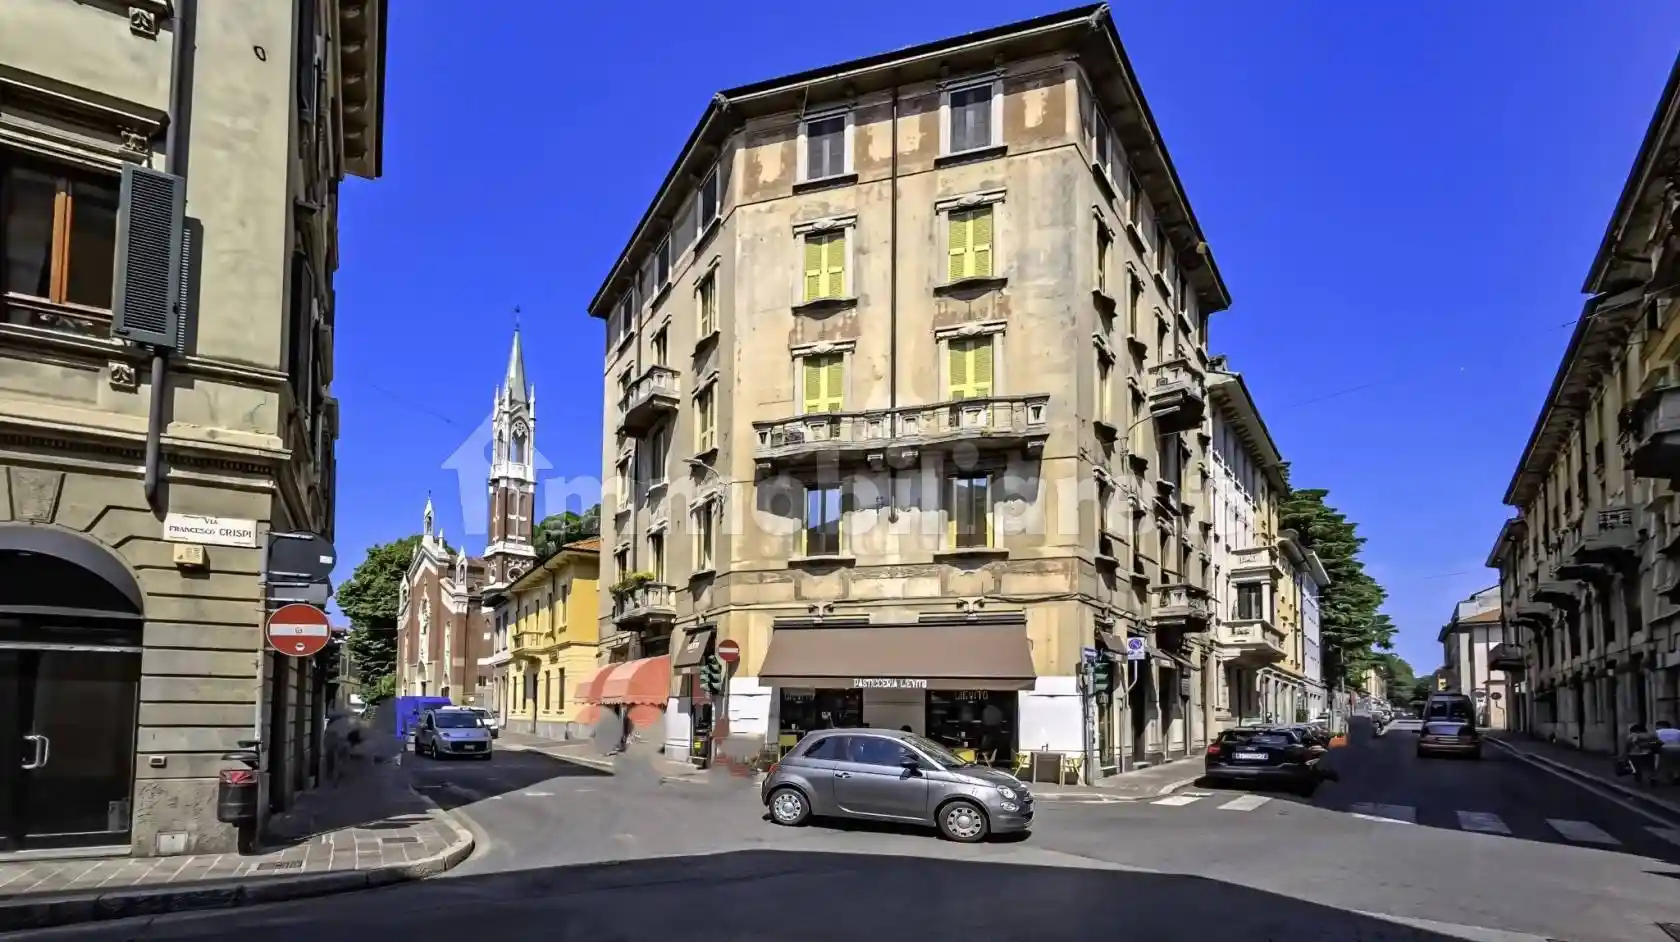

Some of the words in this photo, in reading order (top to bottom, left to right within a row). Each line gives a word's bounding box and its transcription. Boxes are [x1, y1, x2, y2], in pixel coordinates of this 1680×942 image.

[169, 525, 216, 535] FRANCESCO
[219, 528, 252, 538] CRISPI
[853, 678, 898, 688] PASTICCERIA
